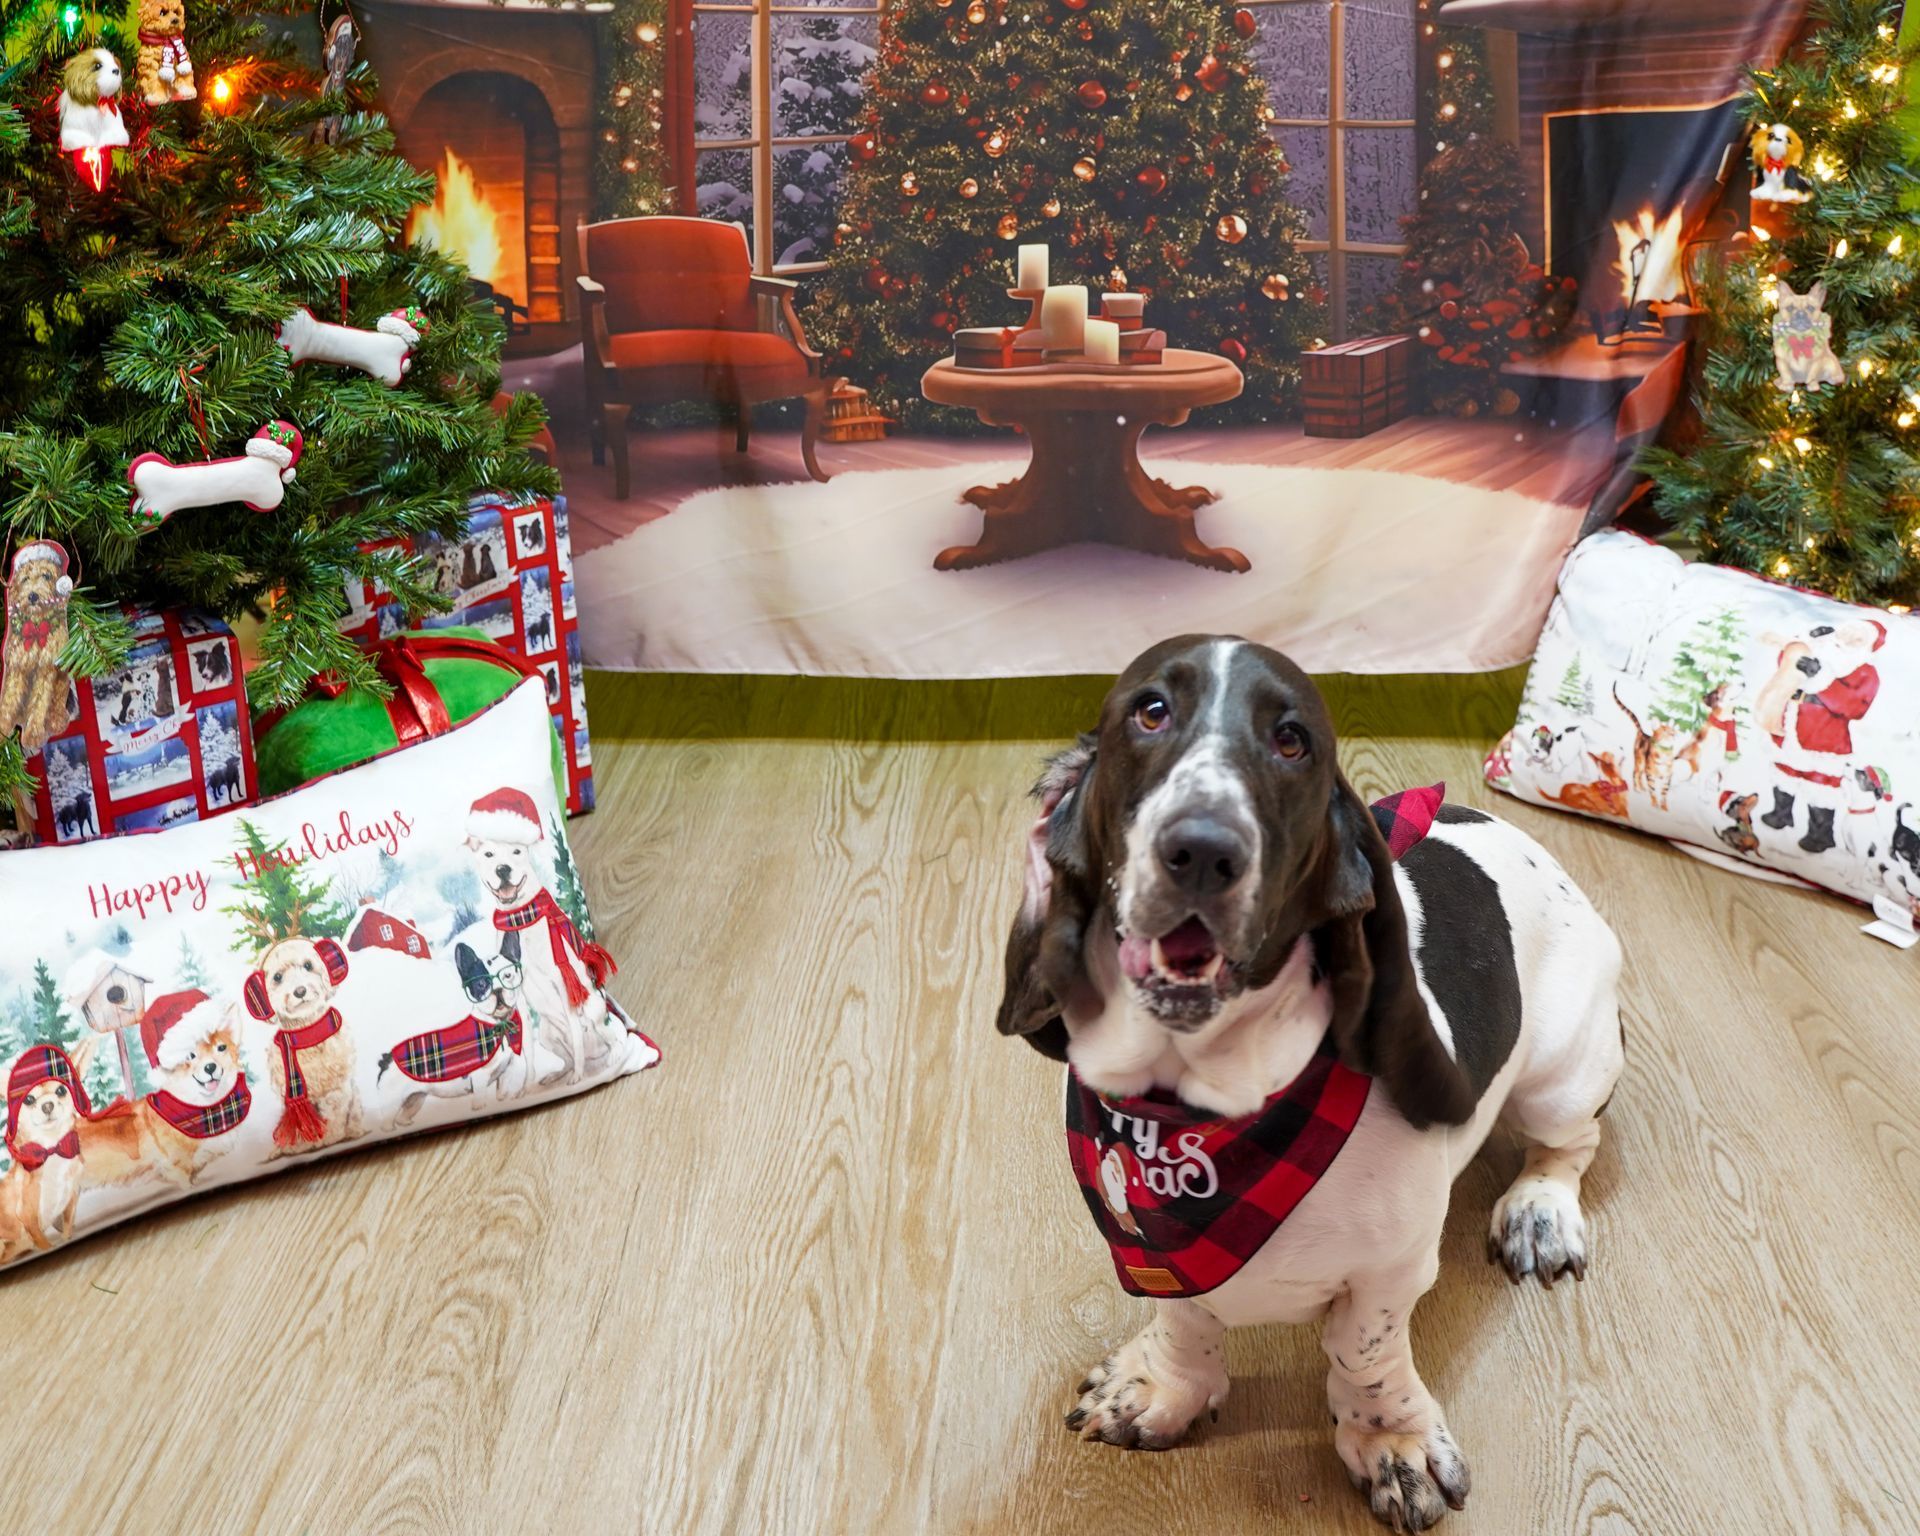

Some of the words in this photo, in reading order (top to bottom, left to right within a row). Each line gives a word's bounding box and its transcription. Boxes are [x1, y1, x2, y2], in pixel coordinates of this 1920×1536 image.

[88, 870, 212, 919] Happy
[234, 809, 415, 881] Howlidays
[1100, 1100, 1159, 1160] ry
